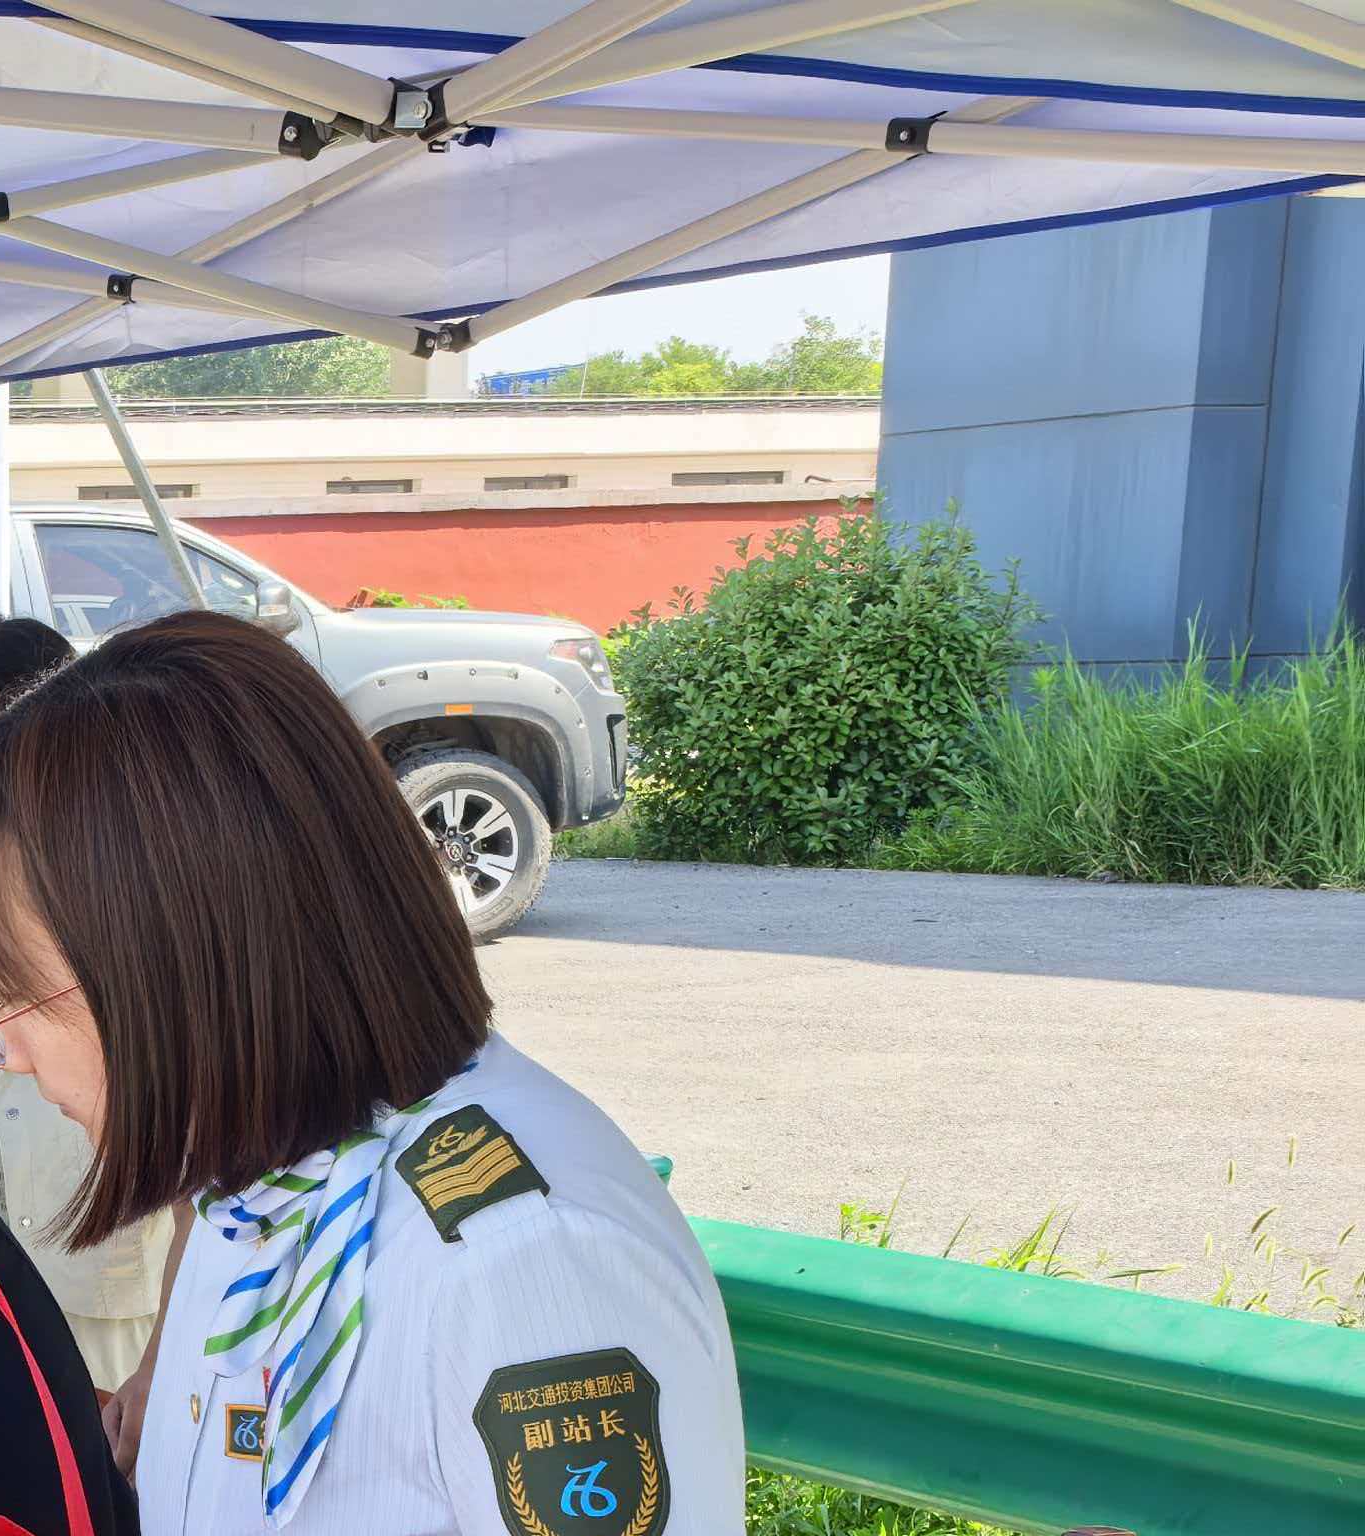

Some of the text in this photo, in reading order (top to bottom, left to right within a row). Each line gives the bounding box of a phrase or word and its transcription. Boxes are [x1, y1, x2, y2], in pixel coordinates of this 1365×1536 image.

[497, 1371, 636, 1415] 河北交通投资集团公司
[521, 1408, 626, 1451] 副站长
